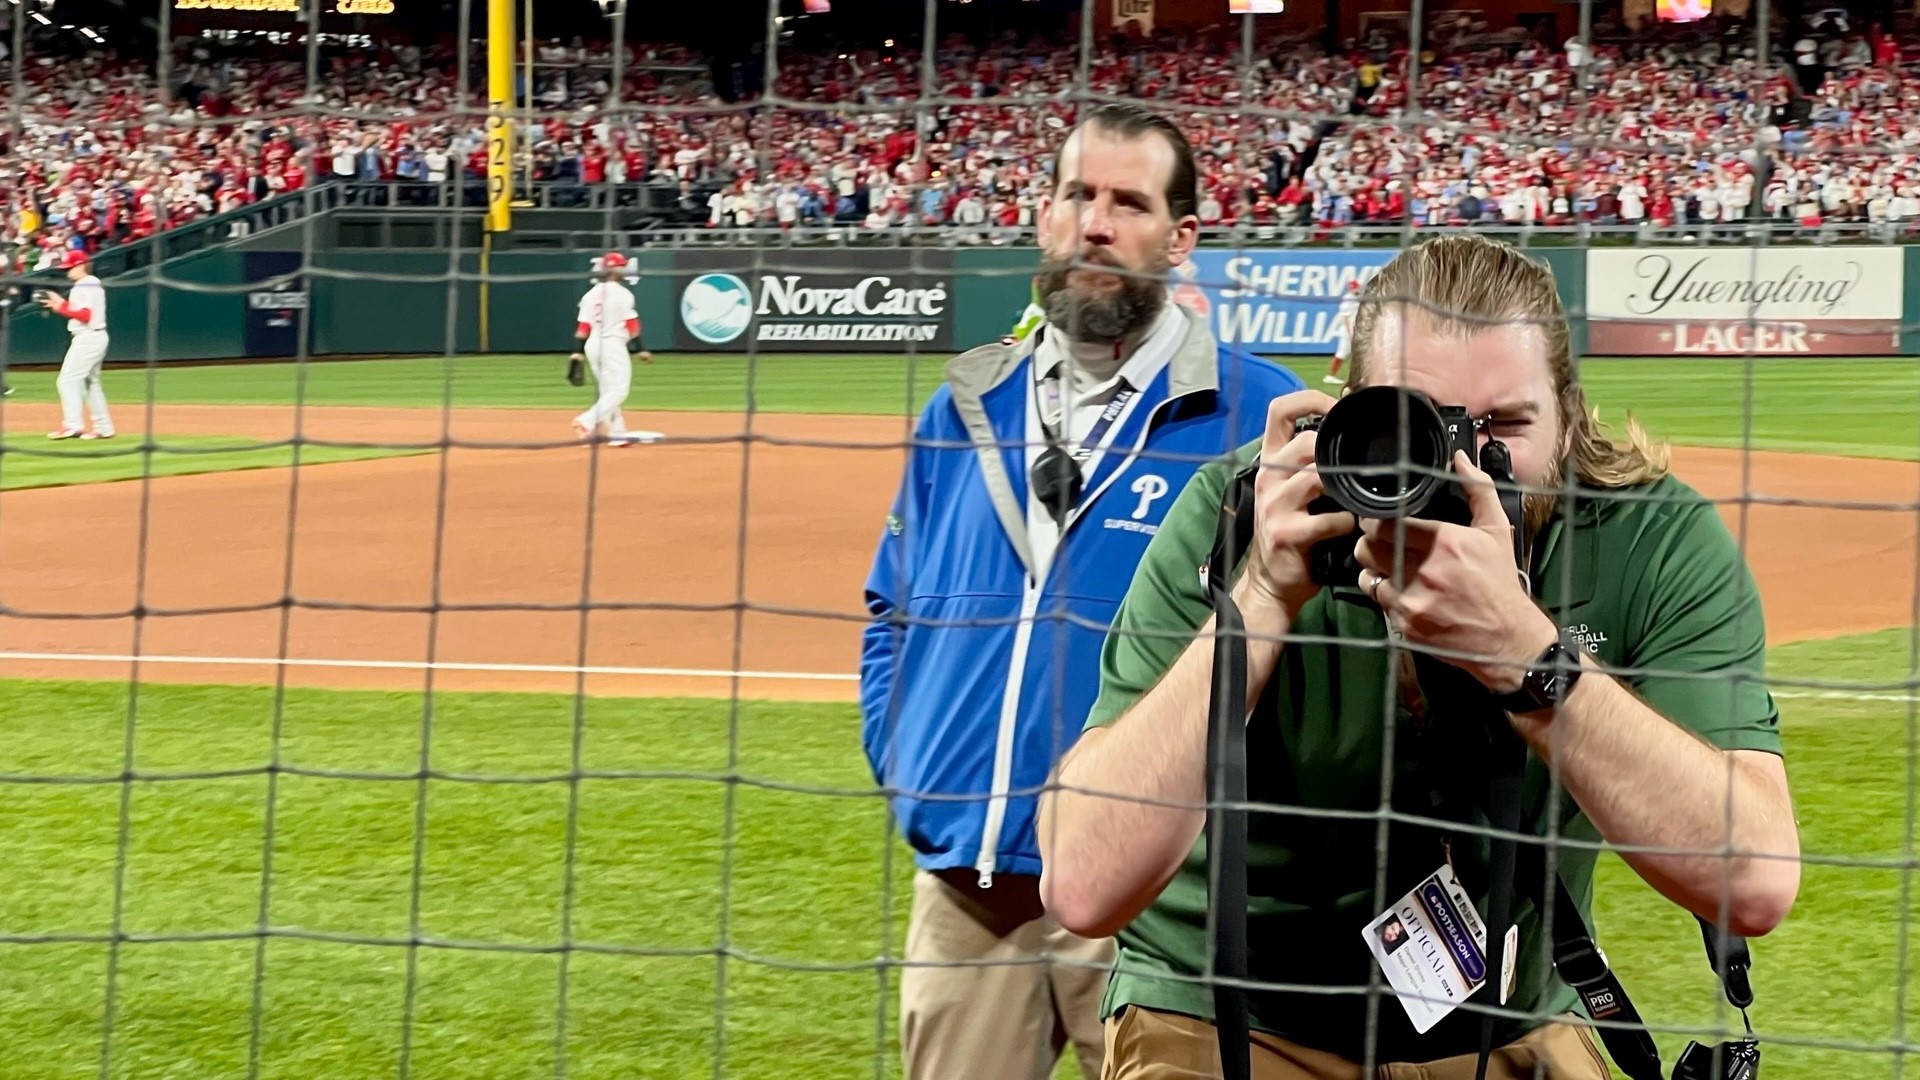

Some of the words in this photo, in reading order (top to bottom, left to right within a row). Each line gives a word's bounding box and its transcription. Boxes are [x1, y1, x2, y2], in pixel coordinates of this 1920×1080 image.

[755, 275, 947, 316] NovaCare
[1219, 257, 1382, 298] SHERW
[1626, 254, 1863, 315] Yuengling
[756, 324, 939, 341] REHABILITATION
[1218, 303, 1346, 344] WILLIA
[1673, 322, 1811, 352] LAGER
[1130, 474, 1169, 519] P
[1402, 907, 1445, 977] OFFICIAL
[1434, 902, 1471, 959] POSTSEASON
[1590, 993, 1614, 1007] PRO
